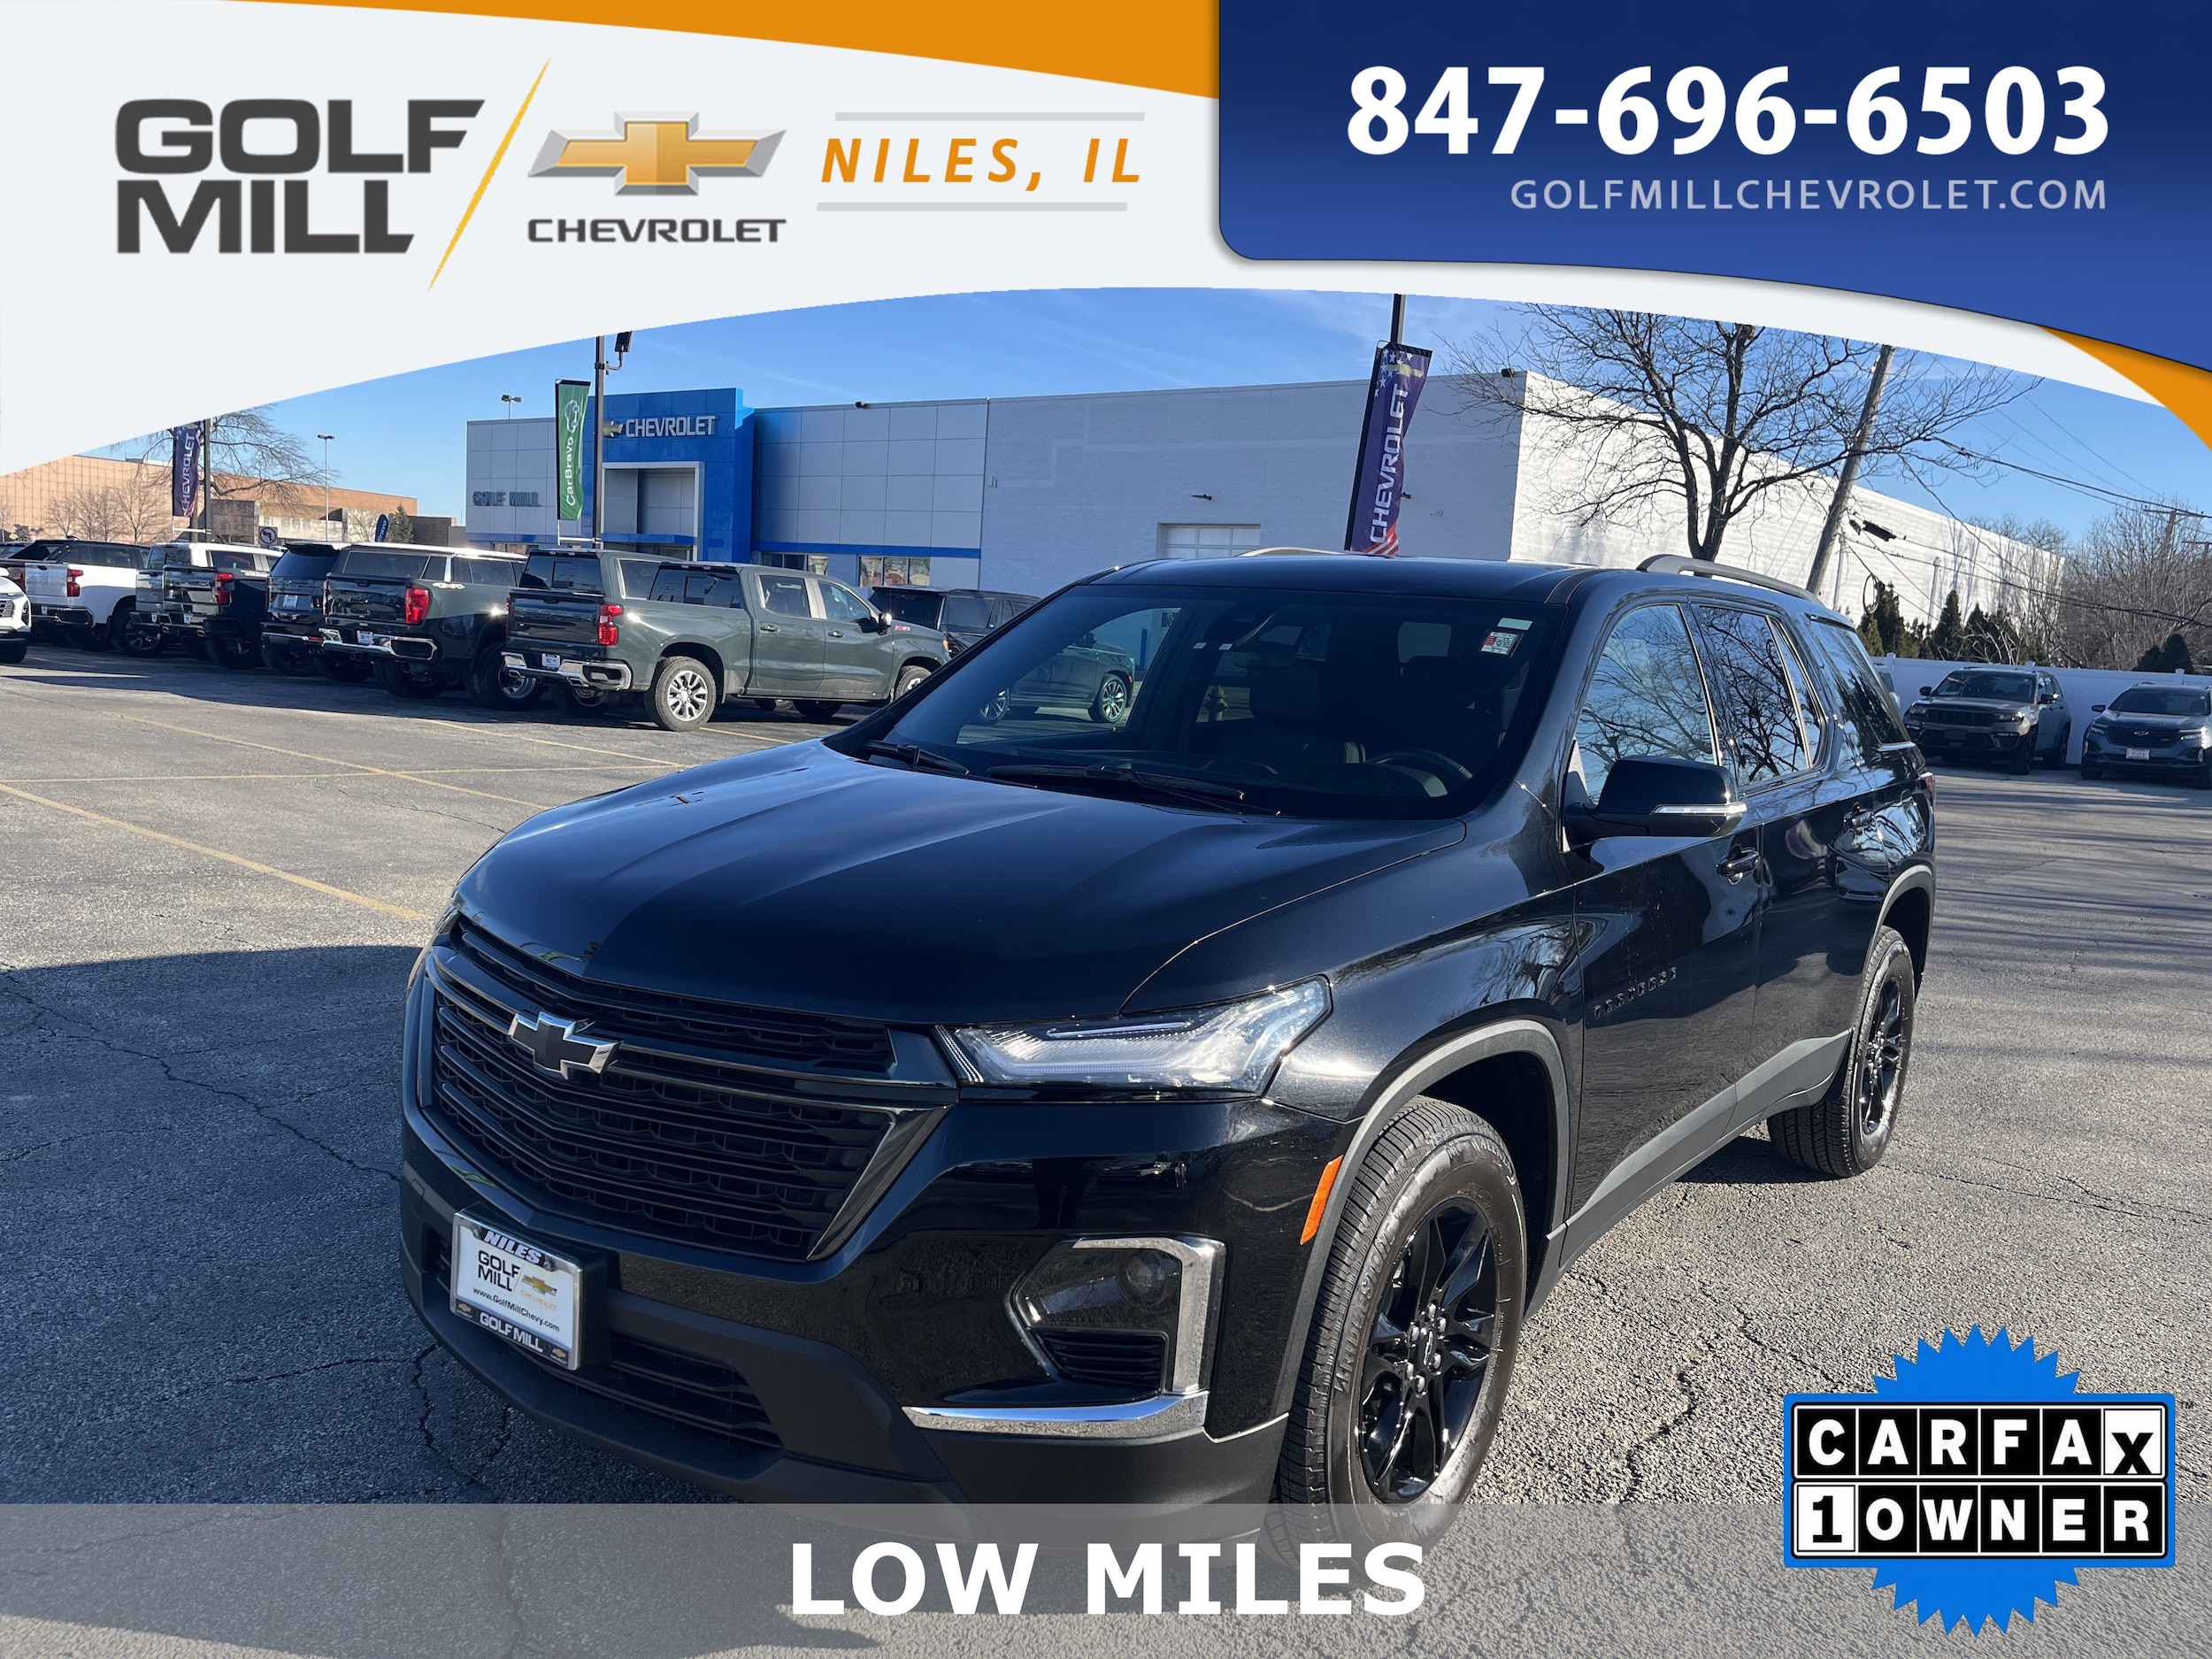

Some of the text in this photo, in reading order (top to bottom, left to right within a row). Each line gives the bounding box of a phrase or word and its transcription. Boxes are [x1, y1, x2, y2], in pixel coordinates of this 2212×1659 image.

[625, 415, 718, 438] CHEVROLET
[181, 433, 196, 512] CHEVROLET
[565, 436, 575, 506] CarBravo
[1370, 383, 1409, 543] CHEVROLET
[478, 1249, 521, 1279] GOLF
[483, 1230, 543, 1265] NILES
[478, 1264, 512, 1292] MILL
[472, 1286, 561, 1333] www.GolfMillChevy.com
[480, 1311, 543, 1354] GOLF MILL
